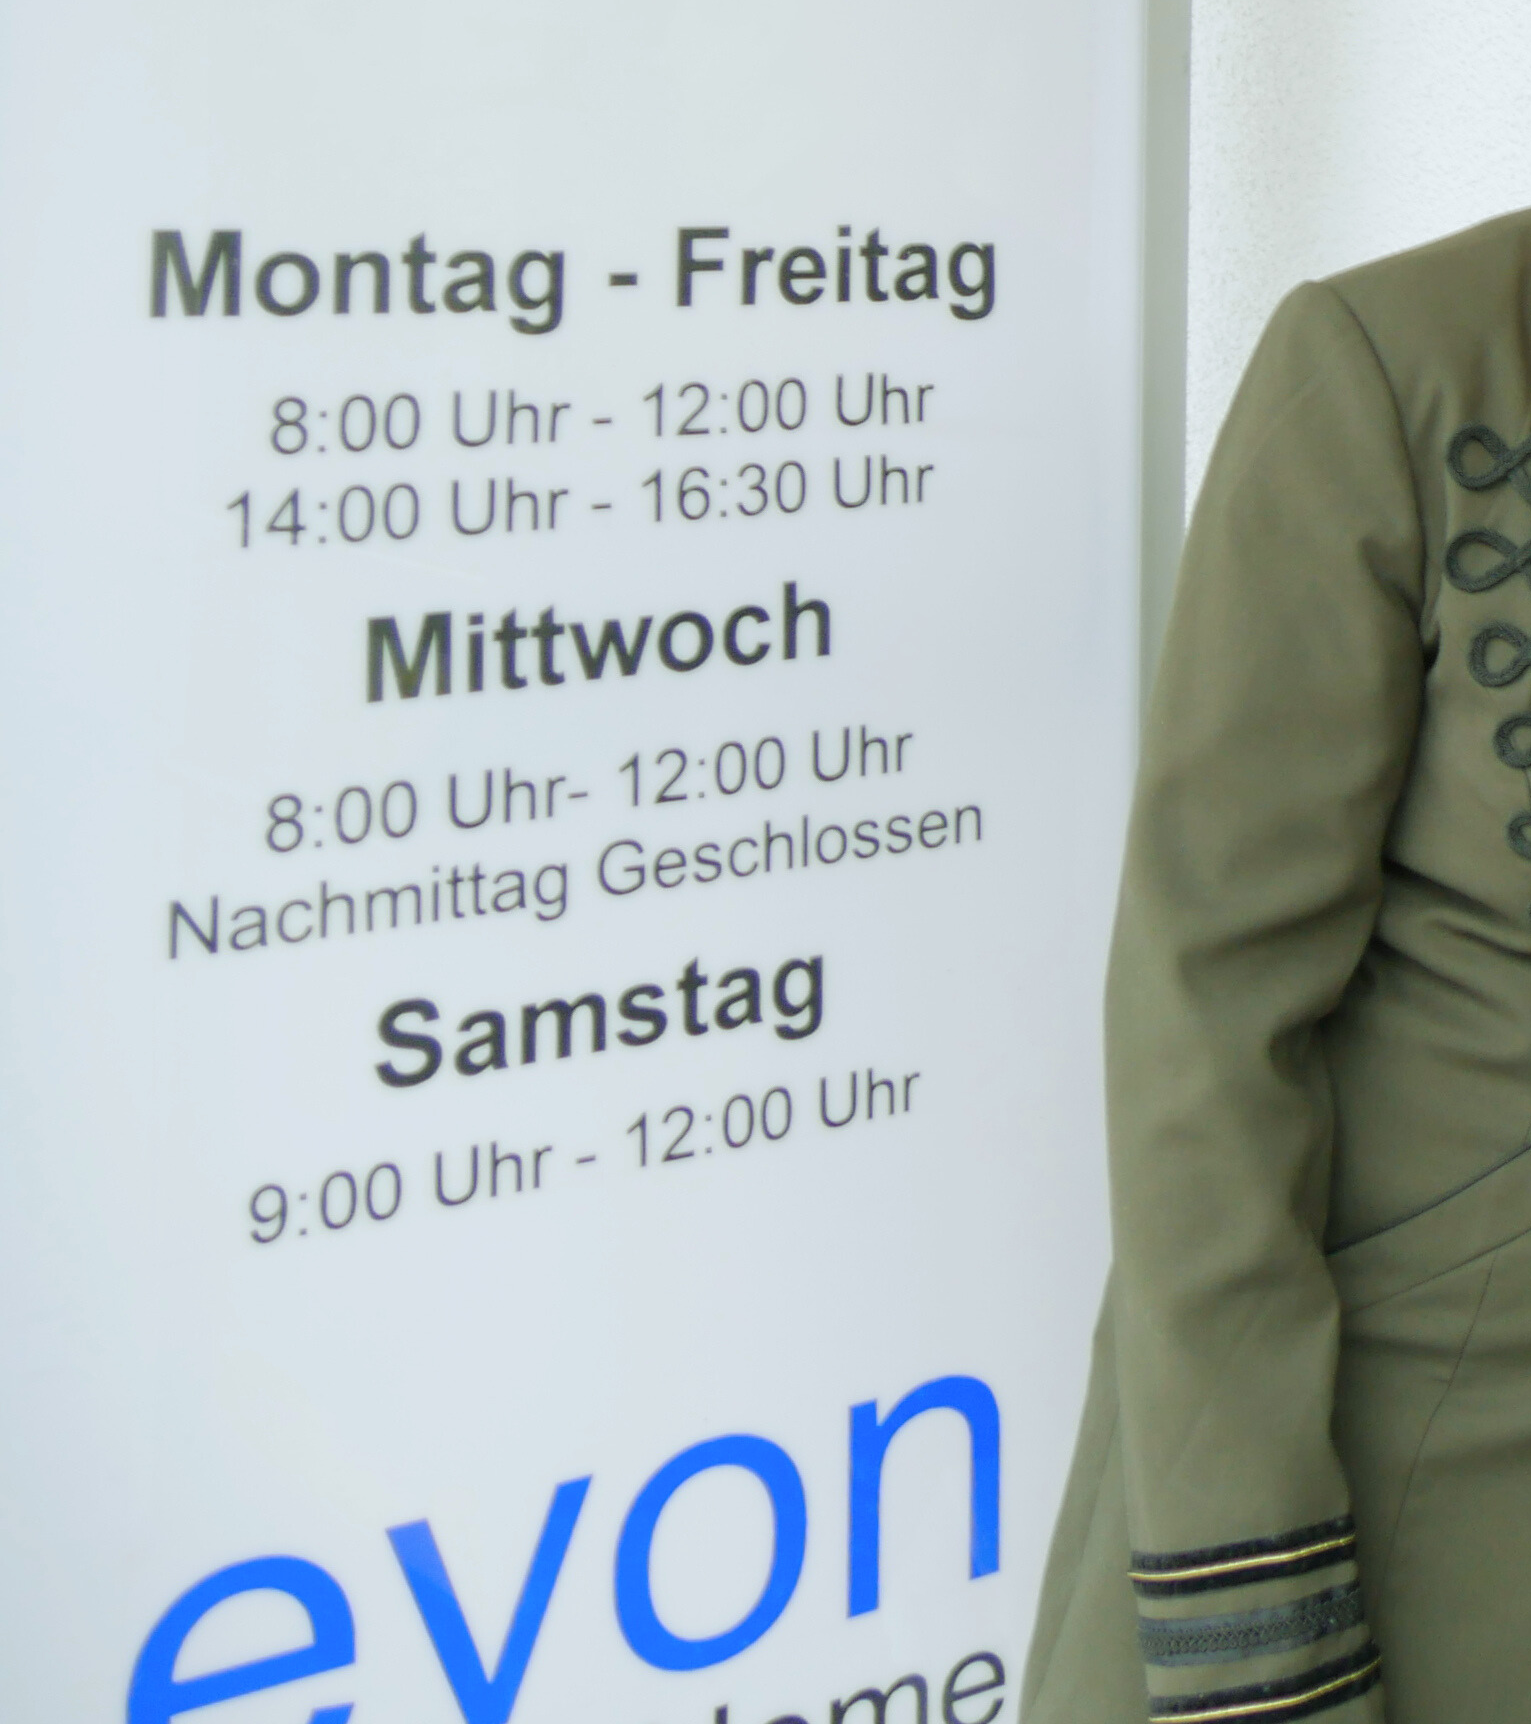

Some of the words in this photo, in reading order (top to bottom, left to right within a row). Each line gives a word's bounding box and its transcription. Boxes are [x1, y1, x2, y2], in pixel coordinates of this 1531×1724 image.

[150, 229, 566, 335] Montag
[609, 272, 638, 286] -
[676, 225, 996, 322] Freitag
[269, 393, 421, 456] 8:00
[451, 389, 571, 449] Uhr
[642, 377, 807, 437] 12:00
[835, 372, 935, 428] Uhr
[227, 482, 421, 549] 14:00
[450, 478, 569, 537] Uhr
[642, 460, 807, 523] 16:30
[832, 454, 935, 509] Uhr
[366, 580, 832, 703] Mittwoch
[265, 779, 418, 854] 8:00
[447, 767, 589, 830] Uhr-
[619, 736, 786, 808] 12:00
[811, 725, 914, 783] Uhr
[168, 862, 569, 960] Nachmittag
[597, 801, 983, 896] Geschlossen
[375, 953, 825, 1088] Samstag
[248, 1161, 403, 1245] 9:00
[434, 1138, 553, 1207] Uhr
[626, 1086, 793, 1168] 12:00
[819, 1067, 921, 1129] Uhr
[125, 1374, 1001, 1724] evon
[715, 1651, 1006, 1724] me
